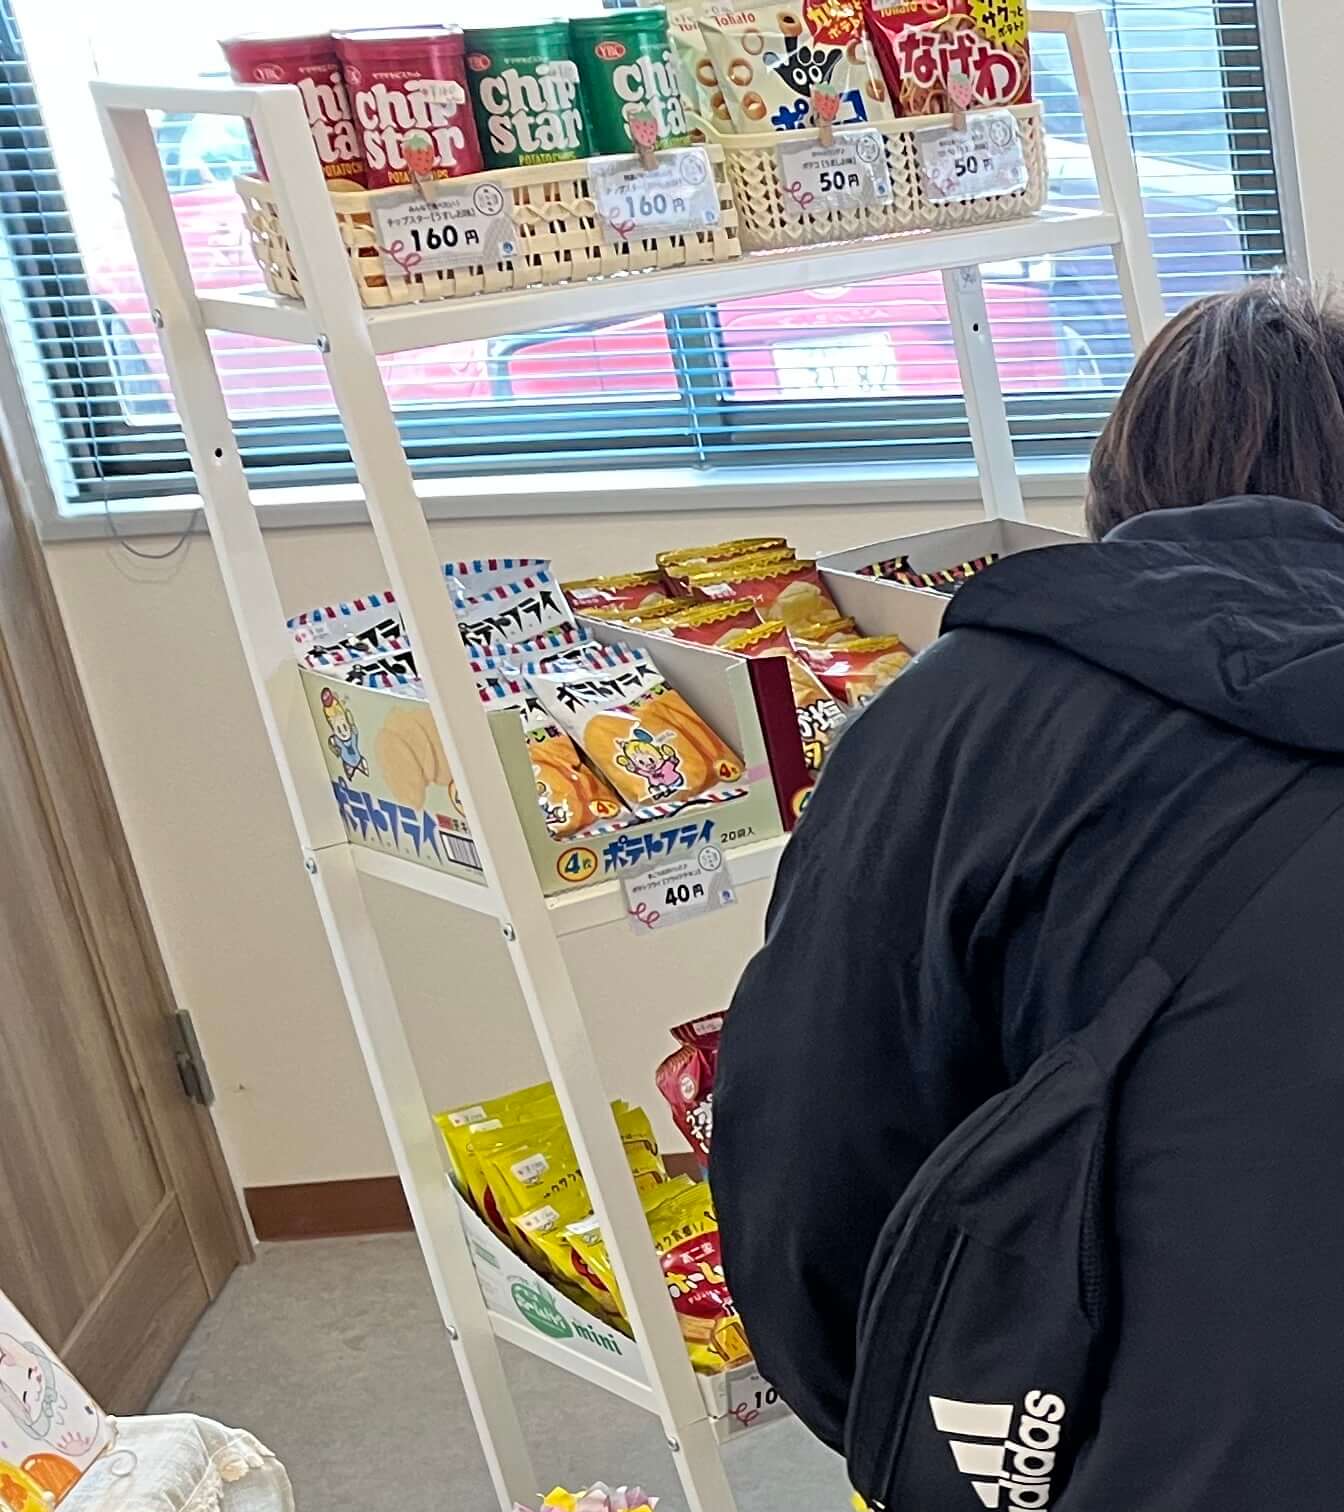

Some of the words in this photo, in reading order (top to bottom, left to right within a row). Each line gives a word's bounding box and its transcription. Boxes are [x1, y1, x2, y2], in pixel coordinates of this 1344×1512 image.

[714, 11, 756, 27] Tohato
[597, 42, 625, 59] YBC
[898, 31, 1018, 100] なげわ
[299, 72, 350, 122] hi
[479, 64, 577, 115] chip
[613, 51, 681, 102] chi
[312, 119, 360, 163] ta
[488, 109, 583, 154] star
[332, 776, 443, 865] ポテトフライ
[603, 819, 715, 873] ポテトフライ
[572, 1320, 623, 1356] mini
